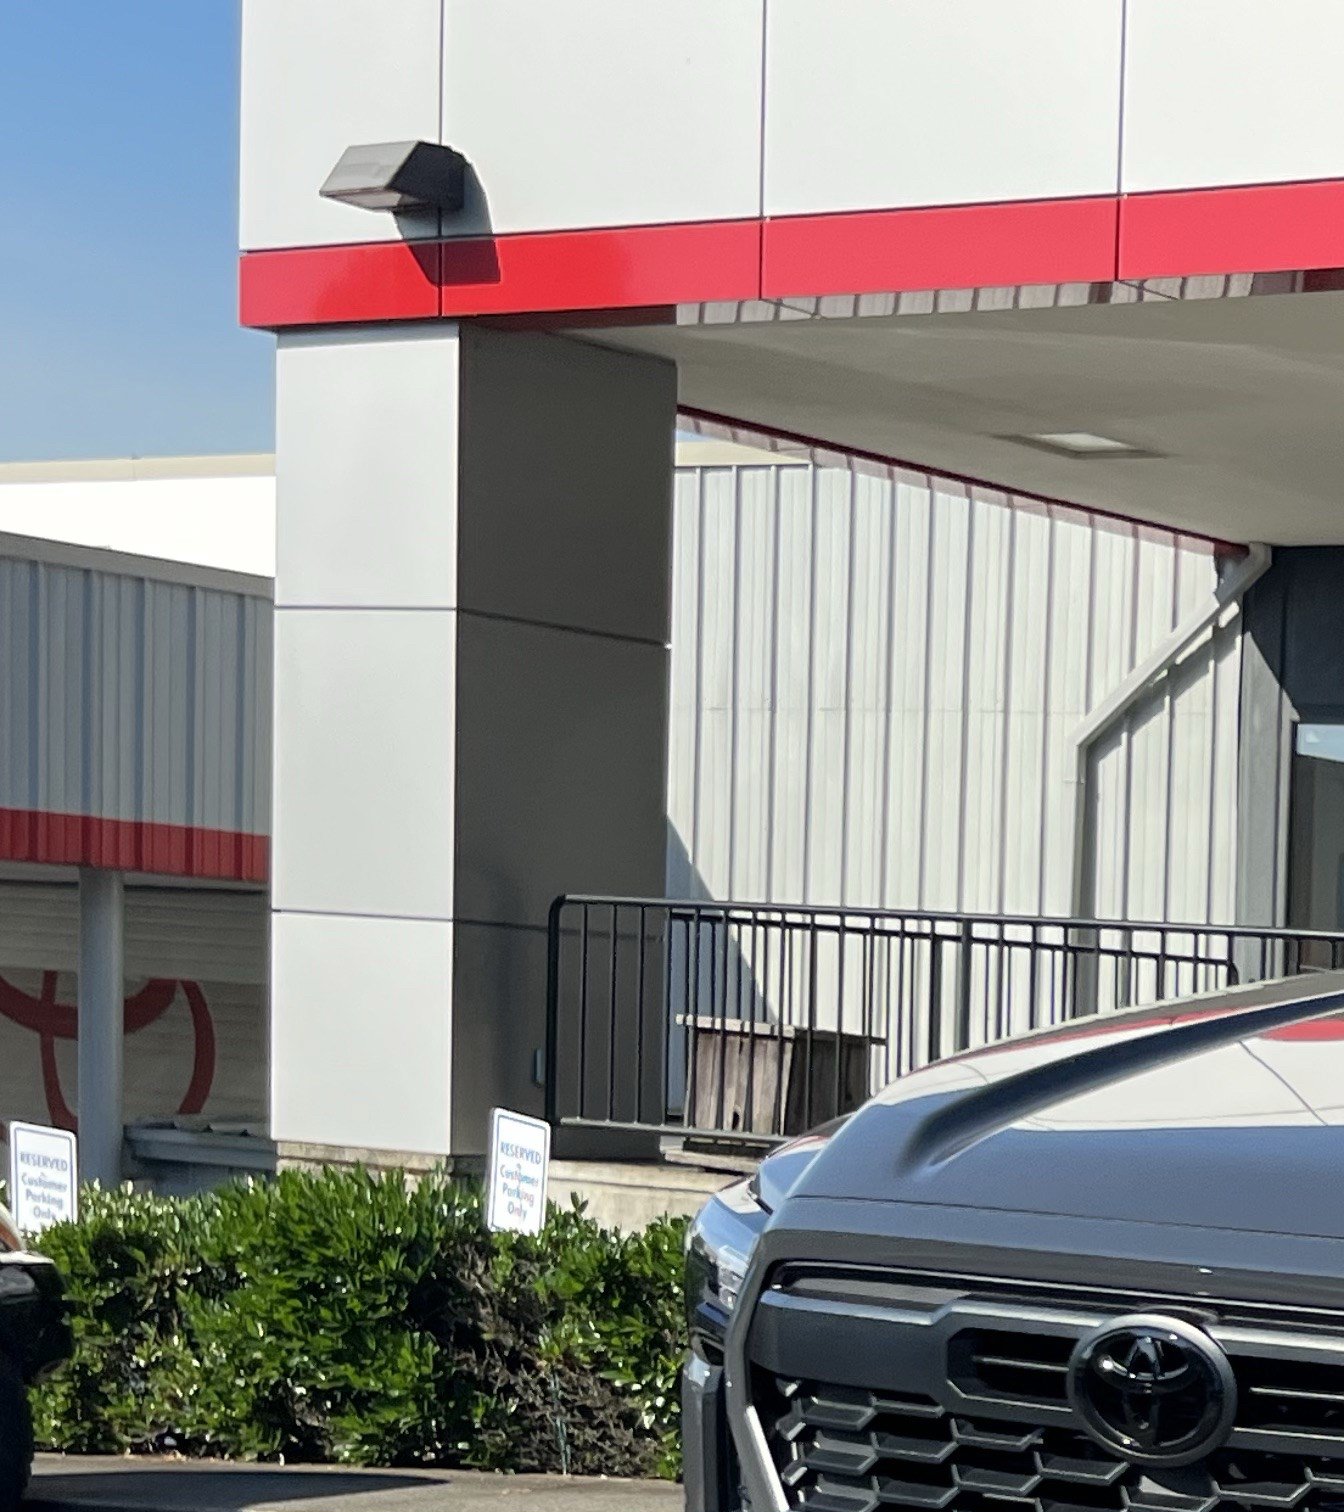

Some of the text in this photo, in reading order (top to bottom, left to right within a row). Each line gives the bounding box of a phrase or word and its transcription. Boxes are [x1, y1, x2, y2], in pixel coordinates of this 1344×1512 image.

[20, 1151, 68, 1172] RESERVED
[500, 1141, 541, 1165] RESERVED
[21, 1172, 67, 1193] Customer
[500, 1164, 538, 1187] Customer
[25, 1188, 63, 1210] Parking
[502, 1182, 534, 1208] Parking
[507, 1200, 527, 1221] Only
